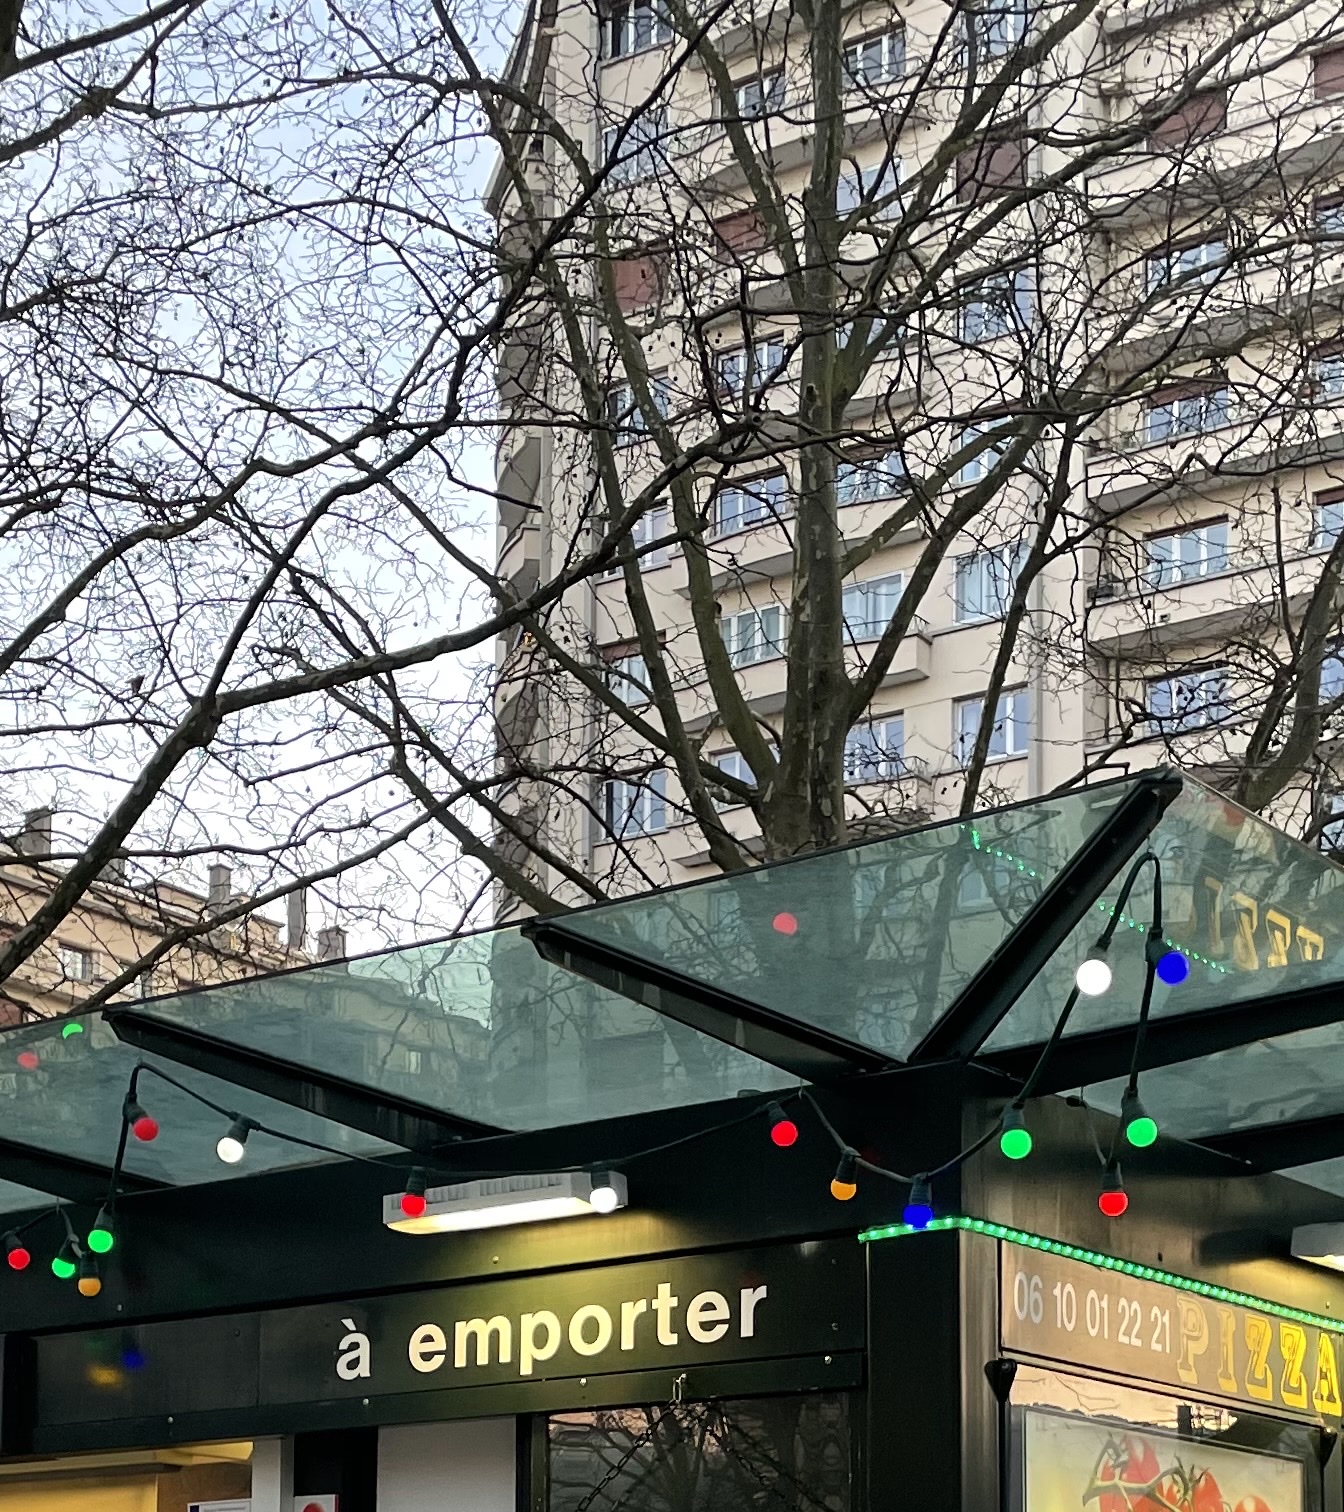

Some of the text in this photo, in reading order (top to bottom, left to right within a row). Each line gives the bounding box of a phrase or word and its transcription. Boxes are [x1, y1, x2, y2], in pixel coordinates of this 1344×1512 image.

[336, 1282, 768, 1381] à emporter
[1013, 1271, 1171, 1354] 06 10 01 22 21
[1175, 1295, 1343, 1418] PIZZA
